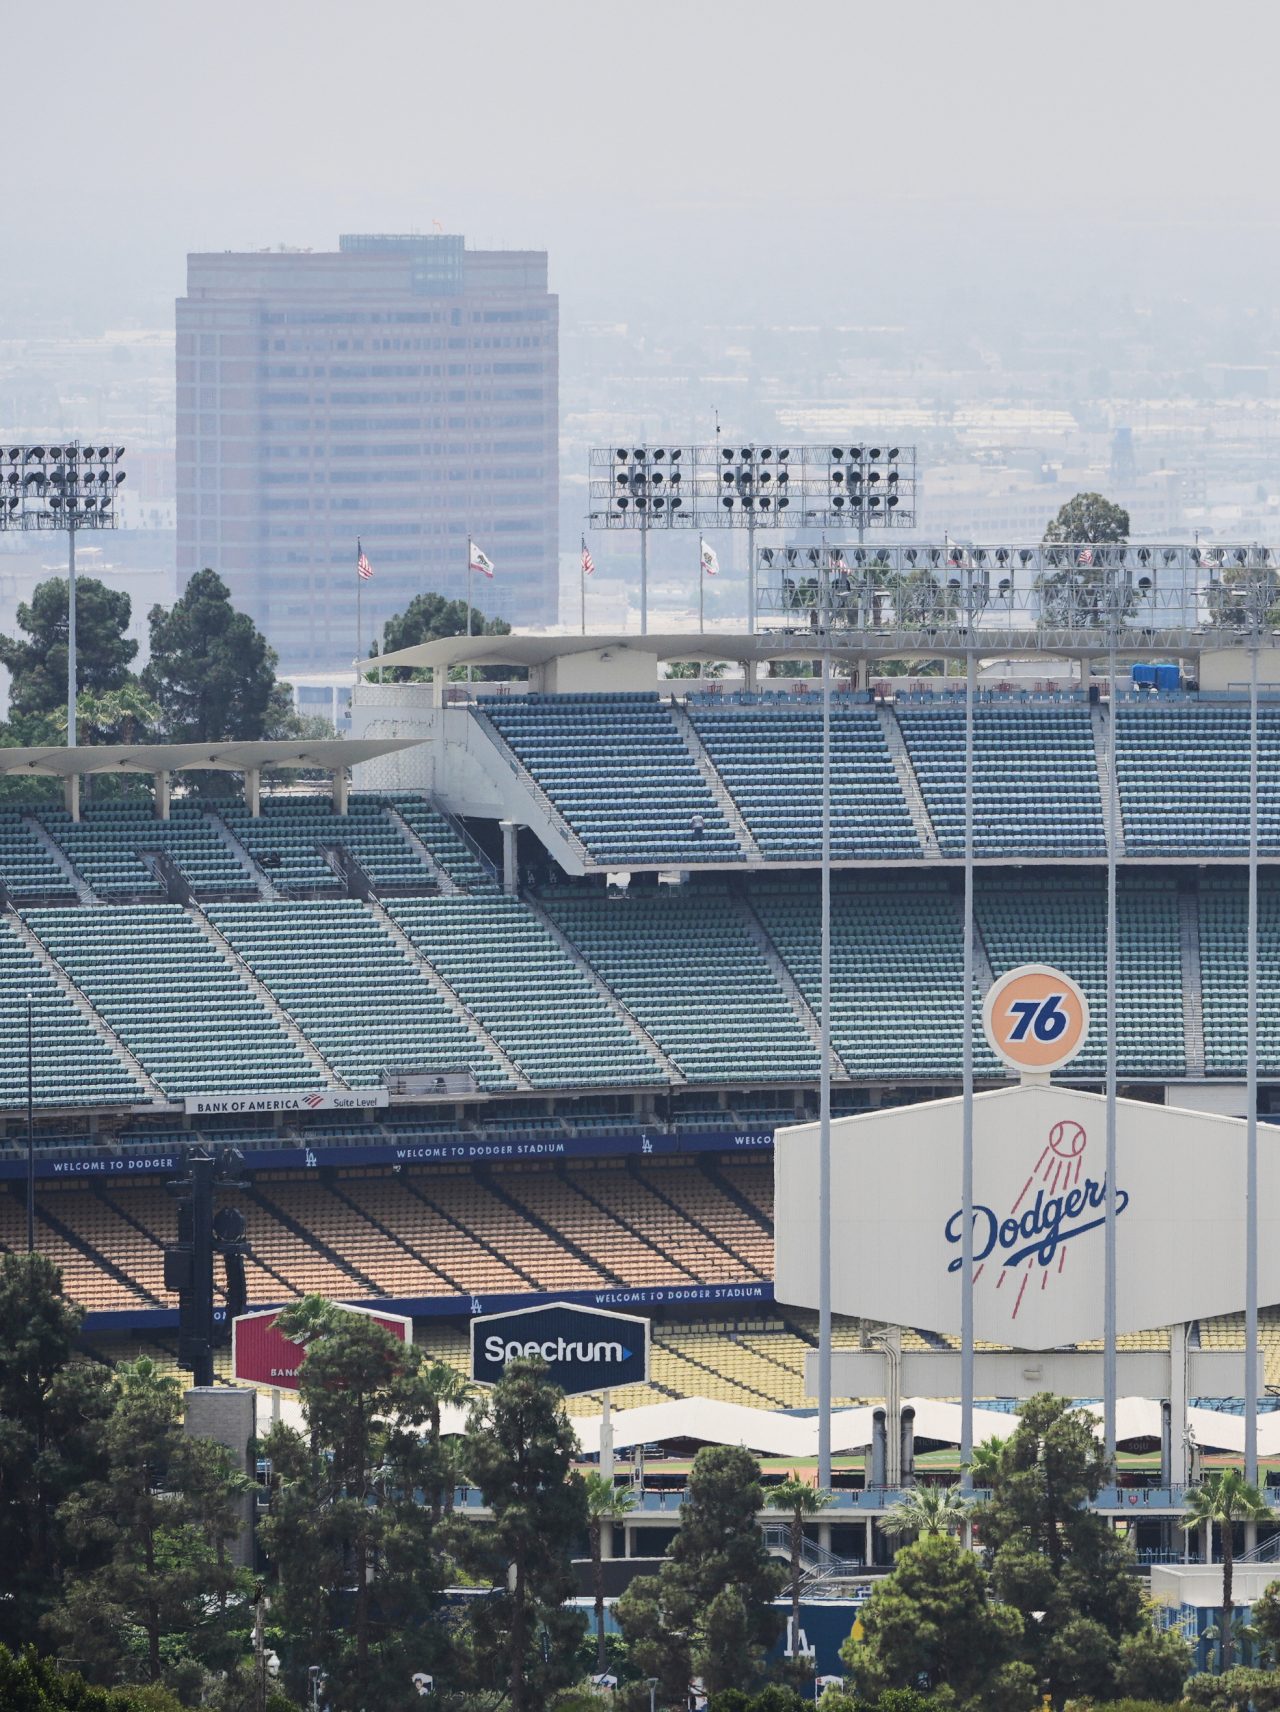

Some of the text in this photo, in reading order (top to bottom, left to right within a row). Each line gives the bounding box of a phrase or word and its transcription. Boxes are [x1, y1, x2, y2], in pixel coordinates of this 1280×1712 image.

[1006, 994, 1069, 1043] 76
[197, 1100, 299, 1113] BANK OF AMERICA
[333, 1097, 377, 1107] Suite Level
[641, 1134, 653, 1153] LA
[734, 1135, 775, 1145] WELCO
[304, 1147, 317, 1167] LA
[396, 1143, 565, 1158] WELCOME TO DODGER STADIUM
[53, 1158, 173, 1172] WELCOME TO DODGER
[595, 1288, 762, 1304] WELCOME TO DODGER STADIUM
[470, 1295, 483, 1314] LA
[484, 1336, 623, 1364] Spectrum
